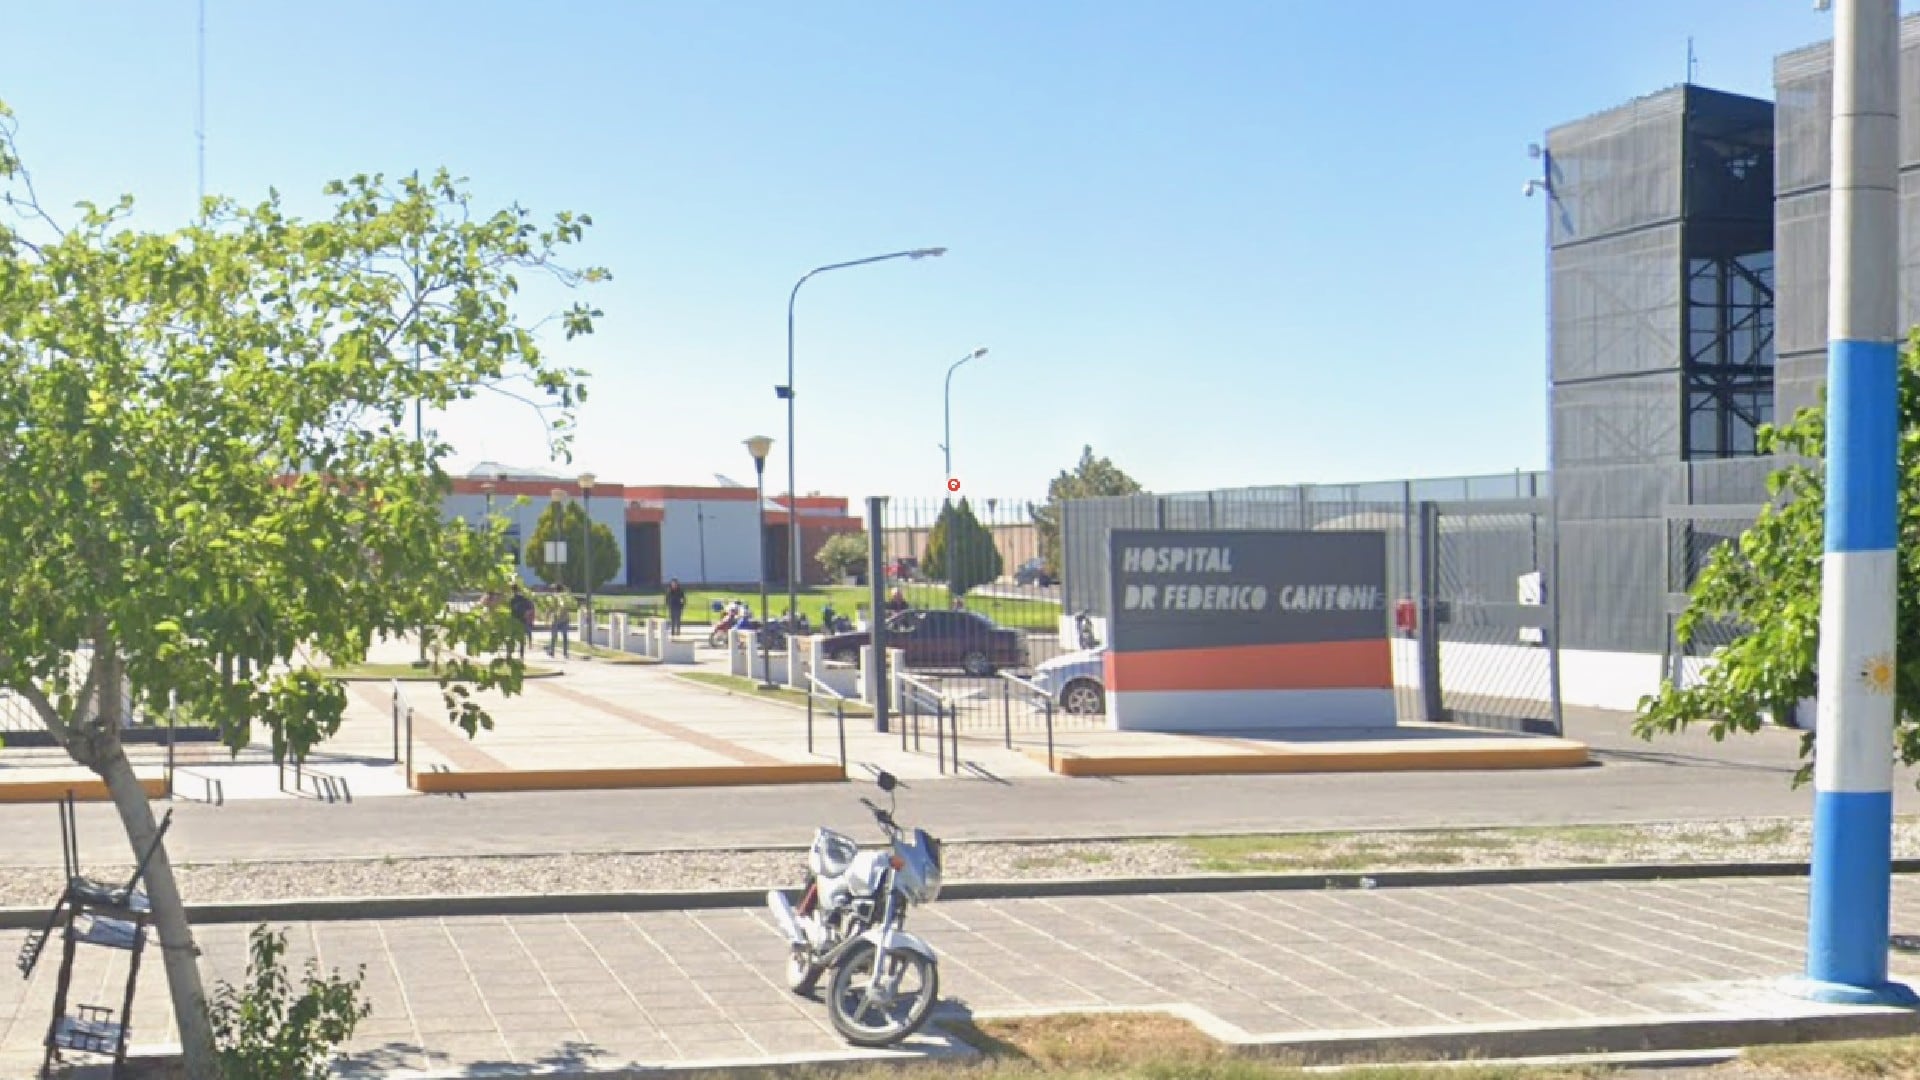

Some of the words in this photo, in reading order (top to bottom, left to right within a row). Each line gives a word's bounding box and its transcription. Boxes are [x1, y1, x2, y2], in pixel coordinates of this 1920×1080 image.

[1123, 546, 1232, 573] HOSPITAL
[1124, 584, 1156, 610] DR
[1163, 584, 1266, 610] FEDERICO
[1280, 584, 1376, 610] CANTONI
